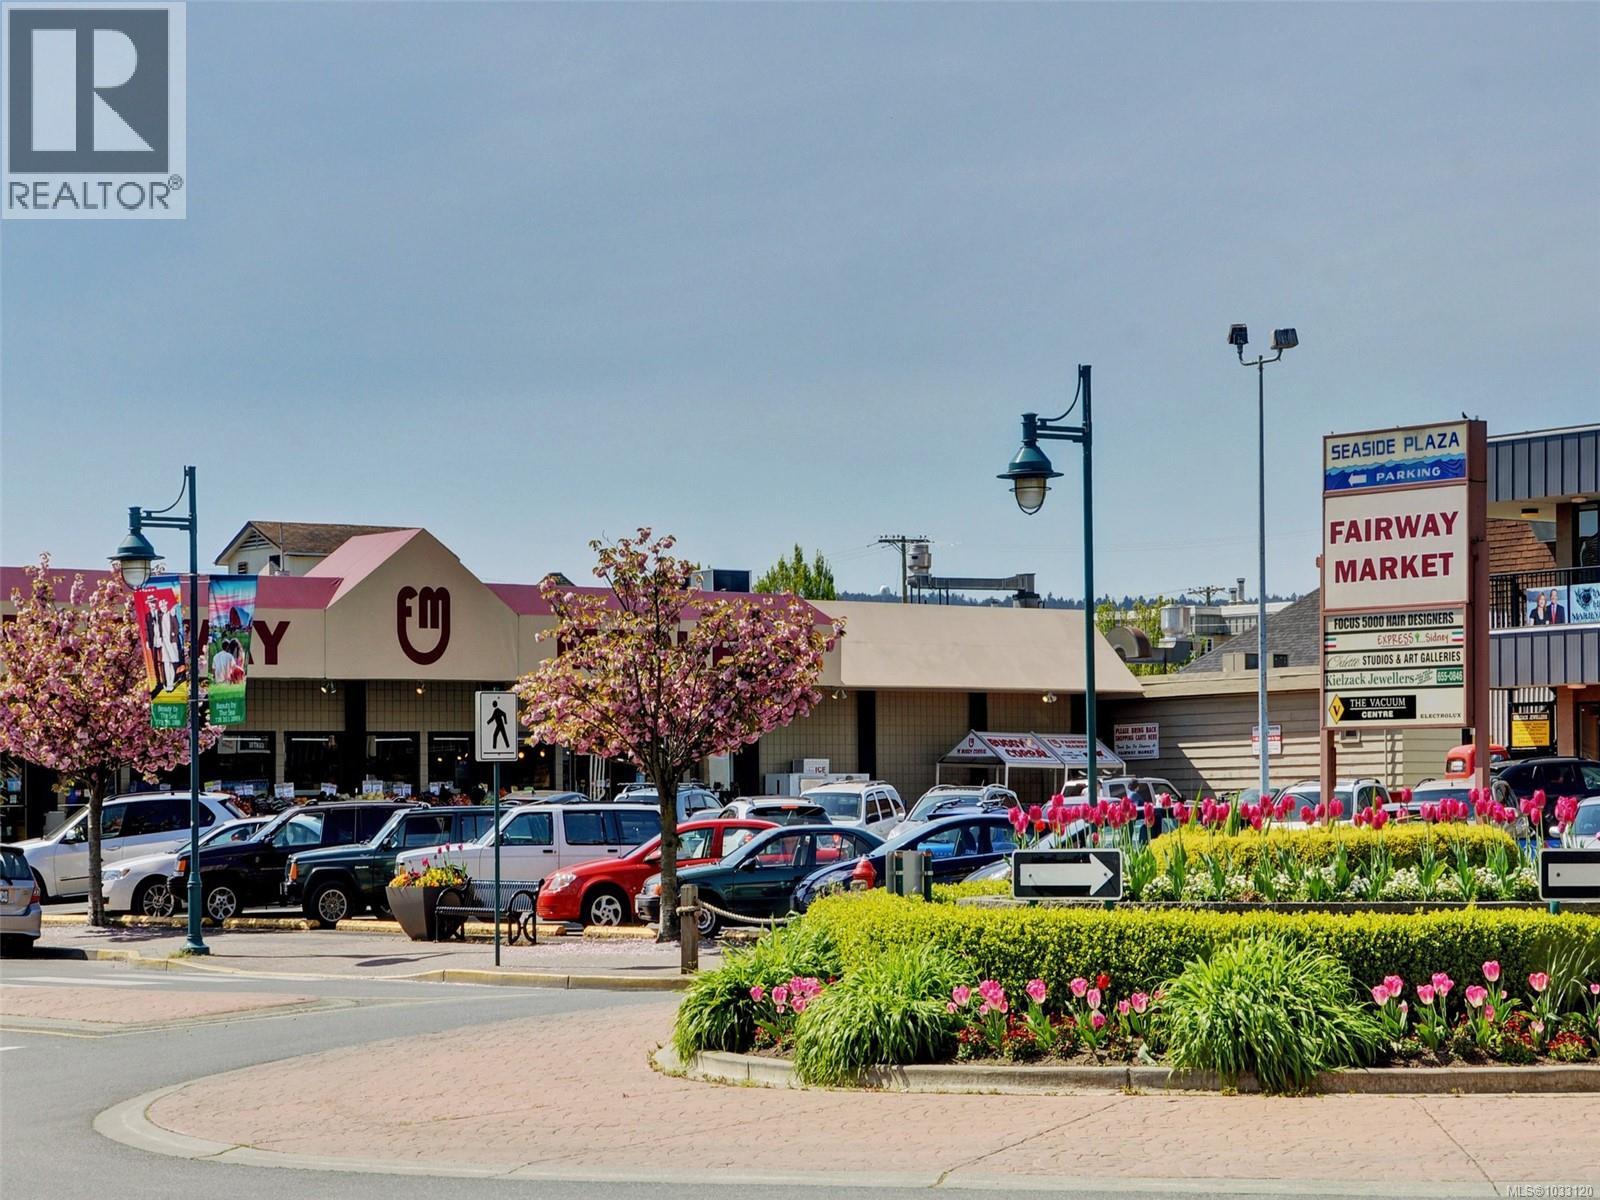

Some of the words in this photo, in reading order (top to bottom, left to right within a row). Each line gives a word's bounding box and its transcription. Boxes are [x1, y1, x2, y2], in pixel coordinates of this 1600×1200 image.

[1331, 439, 1396, 460] SEASIDE
[1404, 432, 1460, 452] PLAZA
[1376, 466, 1441, 482] PARKING
[1330, 511, 1459, 544] FAIRWAY
[1335, 552, 1454, 584] MARKET
[1334, 617, 1360, 630] FOCUS
[1362, 615, 1385, 629] 5000
[1386, 614, 1406, 627] HAIR
[1408, 612, 1454, 626] DESIGNERS
[1377, 632, 1414, 645] EXPRESS
[1362, 654, 1393, 666] STUDIOS
[1396, 654, 1401, 664] &
[1404, 653, 1418, 664] ART
[1420, 651, 1461, 663] GALLERIES
[1325, 672, 1366, 687] Kielzack
[1367, 671, 1415, 686] Jewellers
[1349, 698, 1367, 708] THE
[1370, 697, 1406, 707] VACUUM
[1361, 710, 1394, 719] CENTRE
[815, 766, 826, 774] ICE
